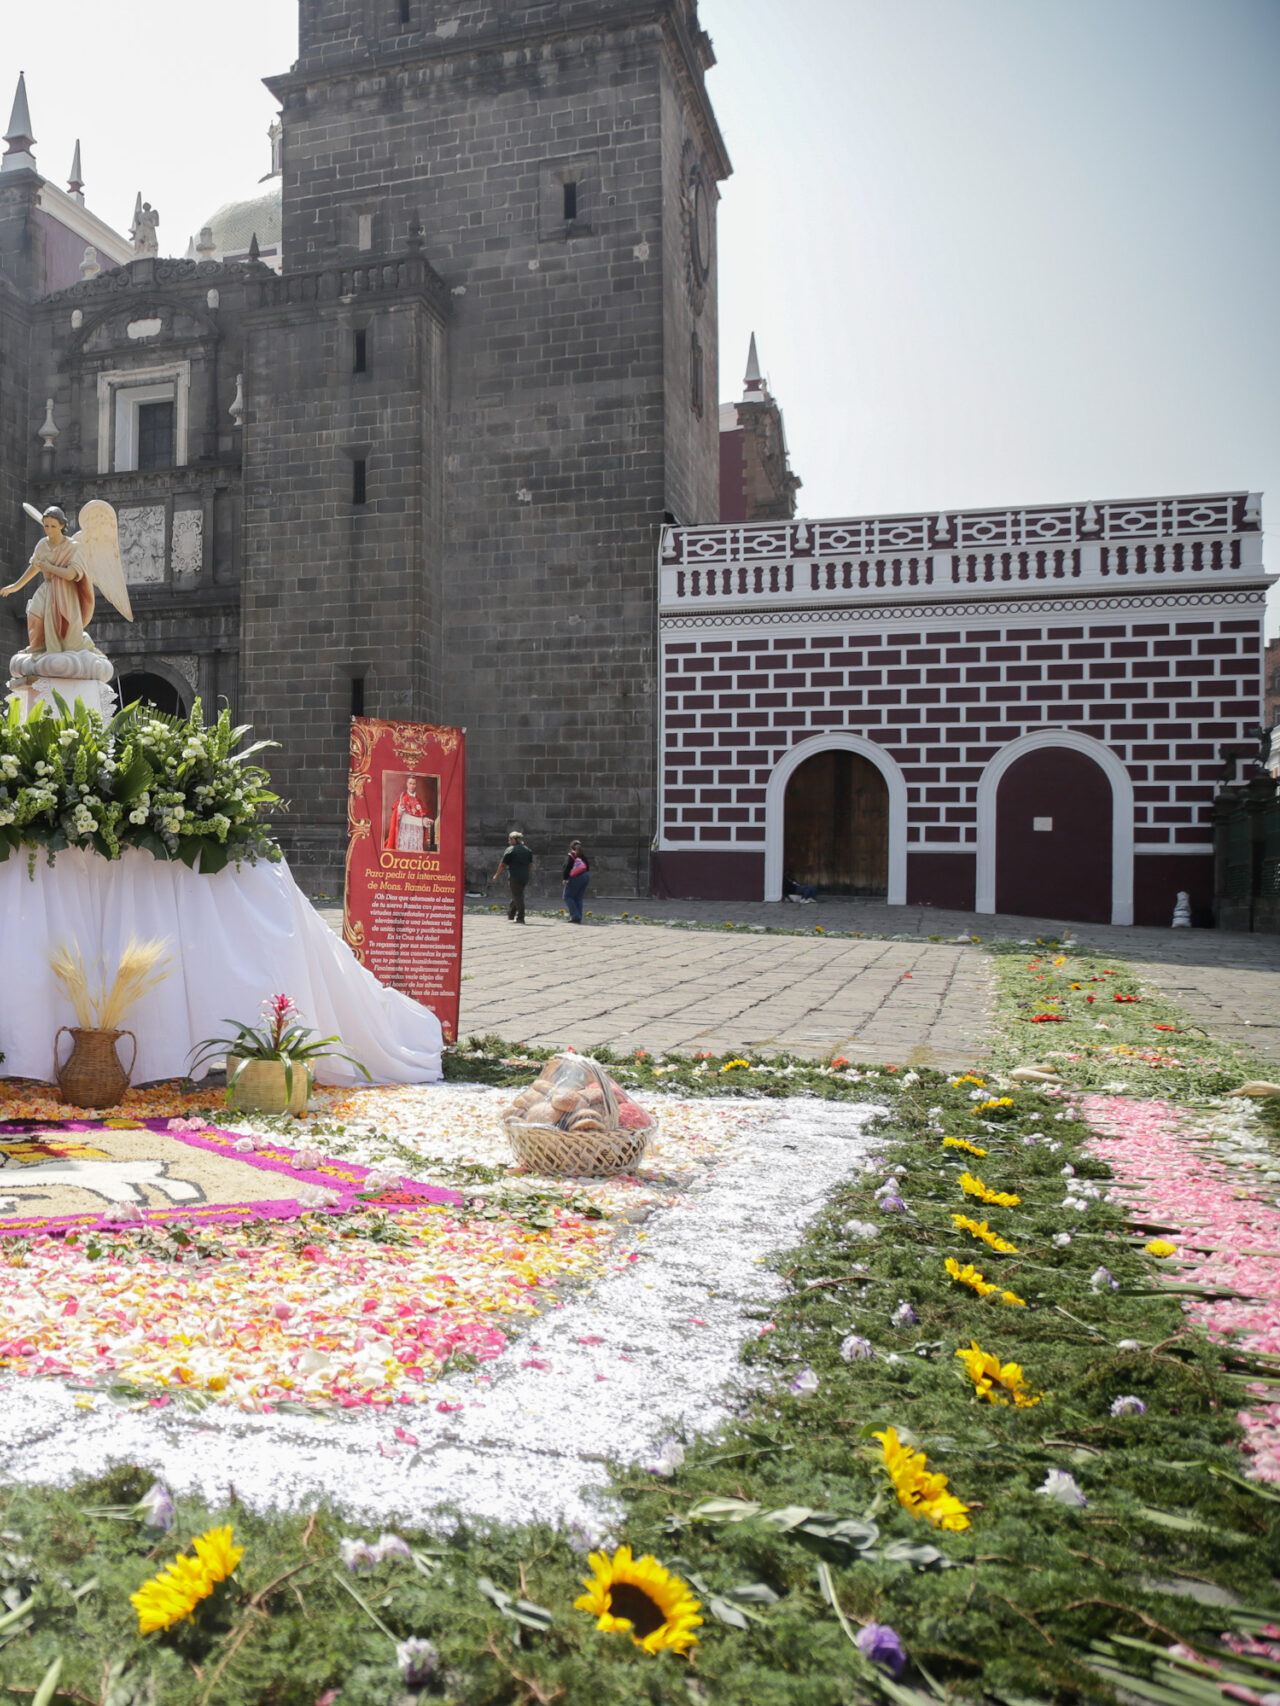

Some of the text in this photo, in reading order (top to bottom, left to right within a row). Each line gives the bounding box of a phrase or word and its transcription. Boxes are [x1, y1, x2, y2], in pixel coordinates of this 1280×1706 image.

[380, 852, 440, 871] Oración
[365, 868, 456, 882] Para pedir la intercesión
[368, 881, 455, 893] de Mons. Ramón Ibarra
